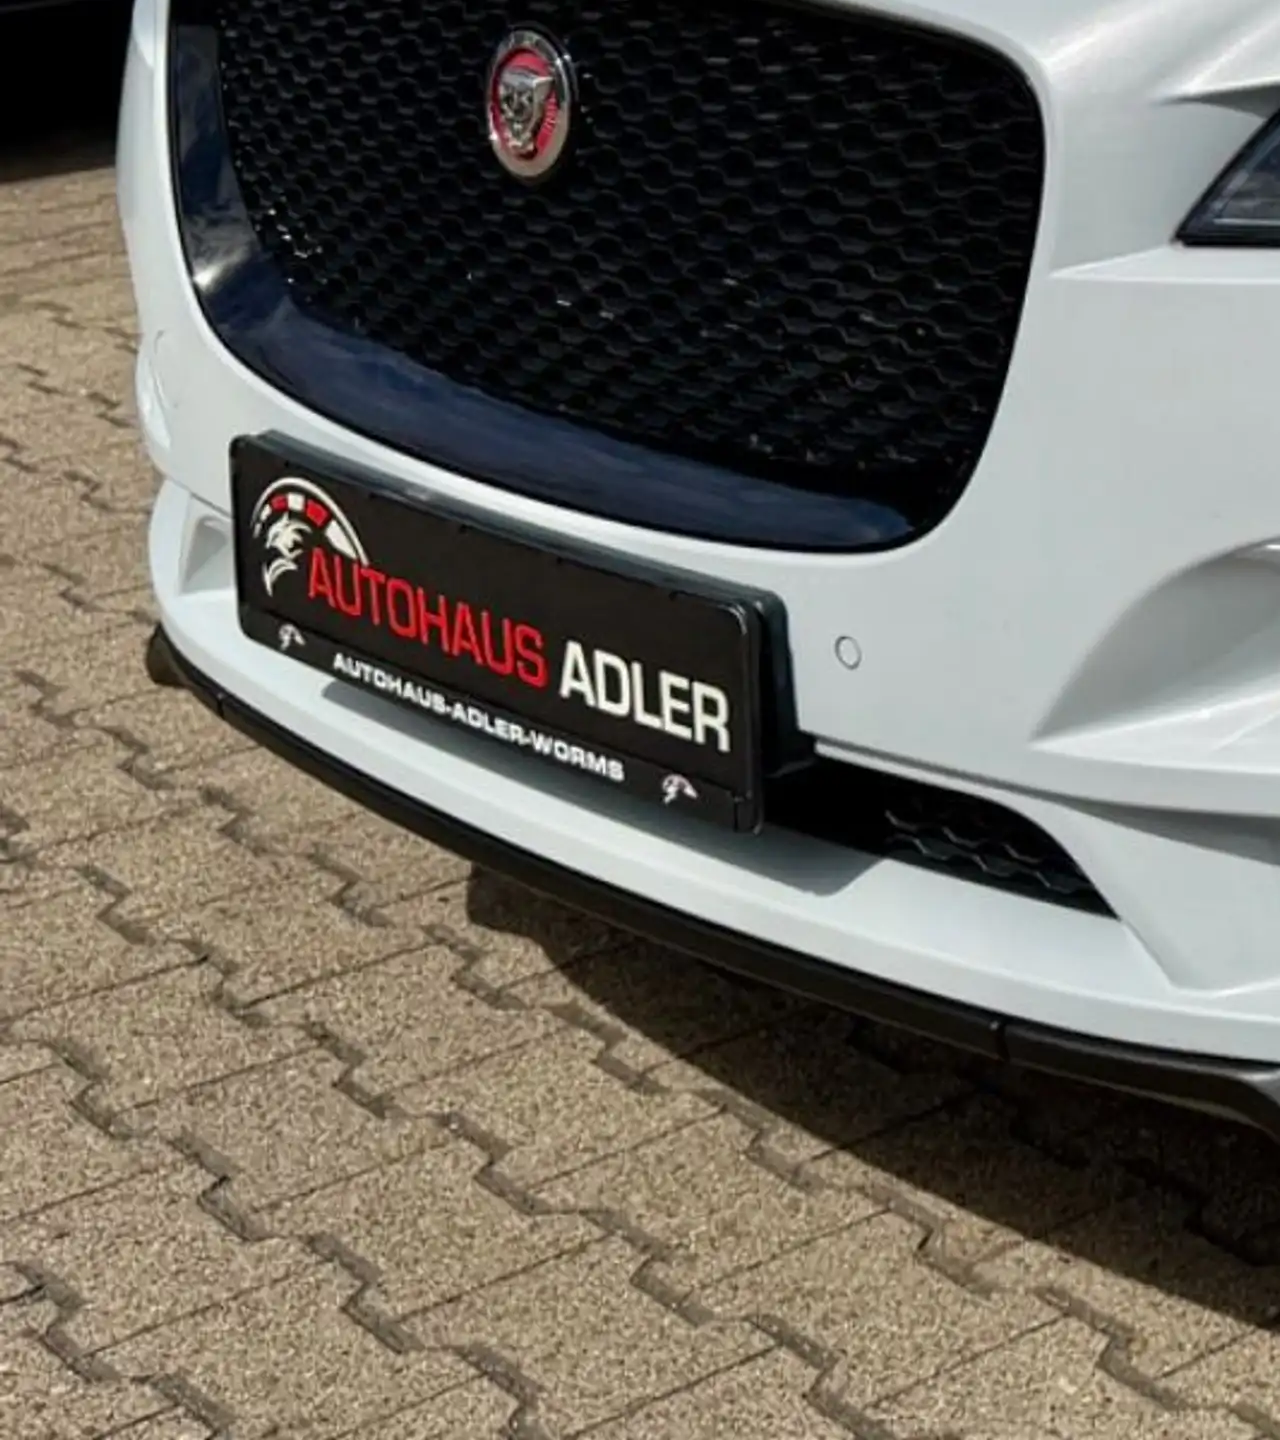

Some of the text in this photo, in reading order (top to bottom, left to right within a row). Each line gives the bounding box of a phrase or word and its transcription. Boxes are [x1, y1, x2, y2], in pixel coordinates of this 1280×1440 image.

[307, 546, 732, 752] AUTOHAUS ADLER
[332, 653, 626, 782] AUTOHAUS-ADLER-WORMS
